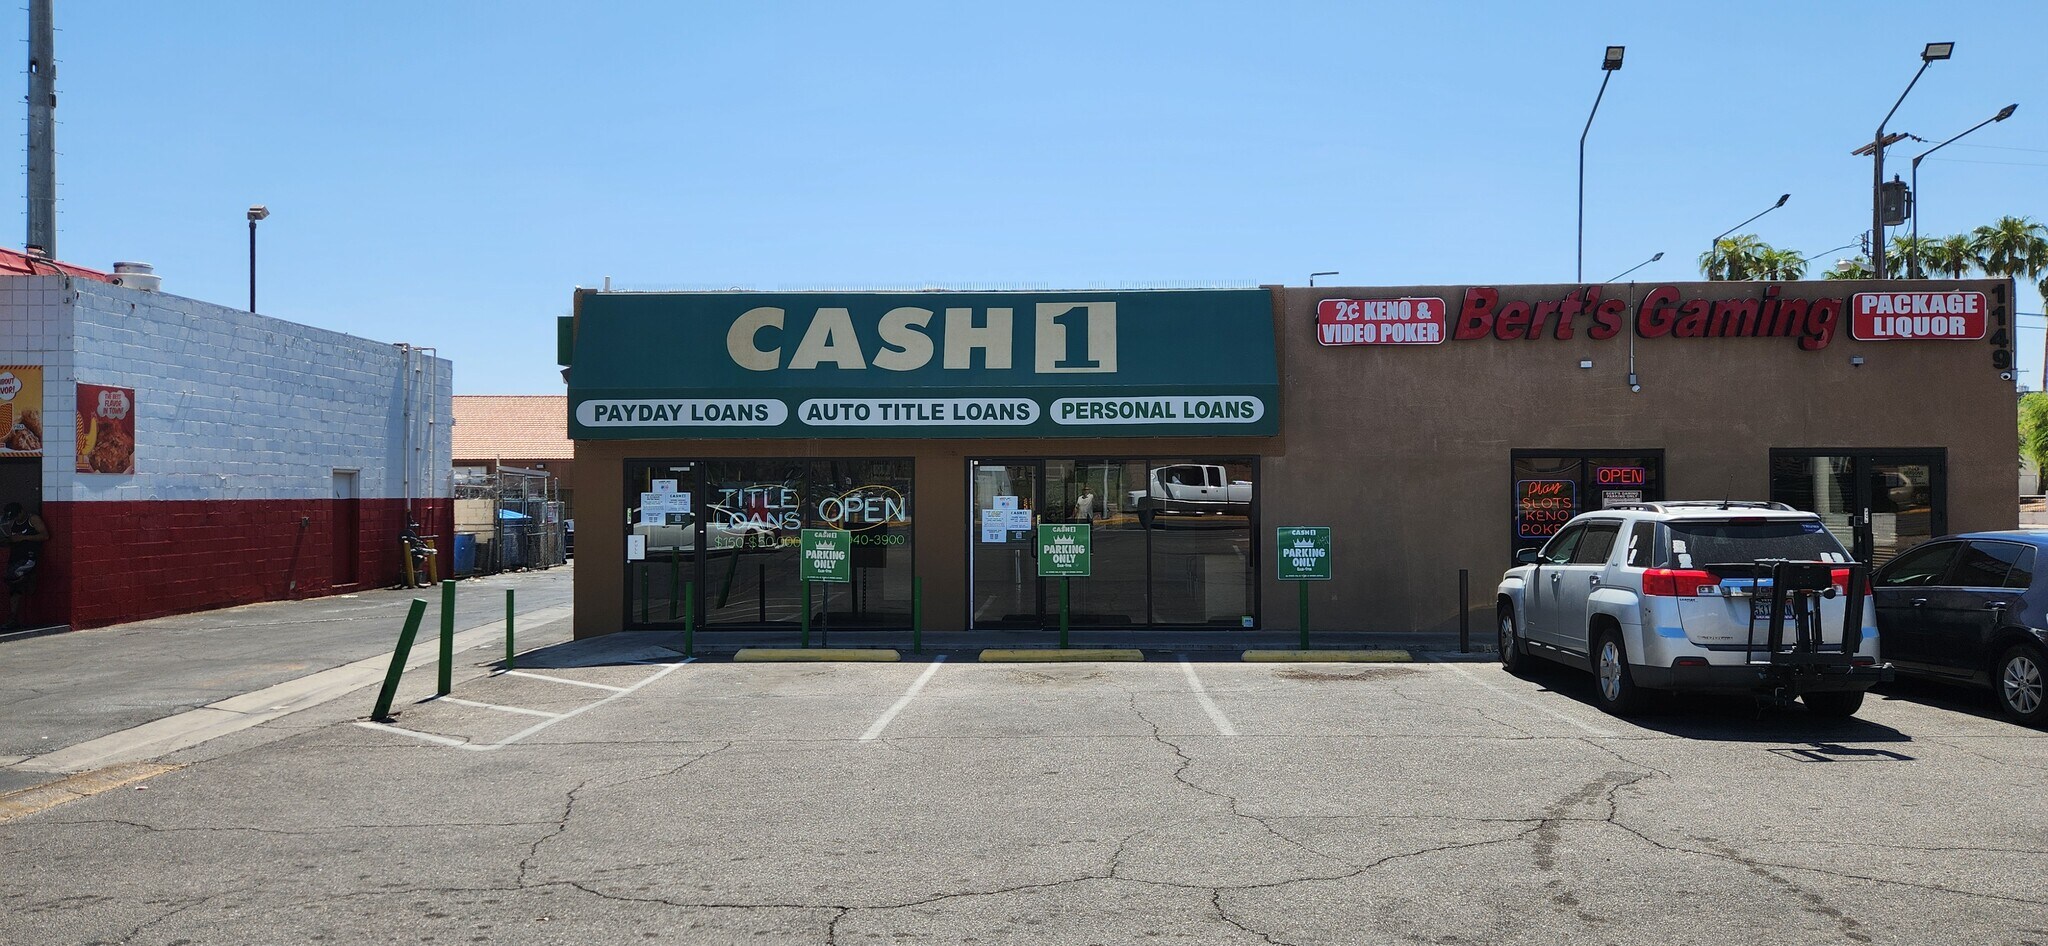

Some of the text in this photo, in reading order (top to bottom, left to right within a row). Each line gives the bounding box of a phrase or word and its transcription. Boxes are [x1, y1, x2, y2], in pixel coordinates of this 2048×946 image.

[1335, 301, 1432, 321] 2¢ KENO &
[1861, 294, 1979, 315] PACKAGE
[1452, 285, 1842, 350] Bert's Gaming
[1990, 283, 2011, 370] 1149
[1322, 322, 1440, 343] VIDEO POKER
[1873, 316, 1966, 338] LIQUOR
[726, 306, 1013, 371] CASH
[594, 404, 769, 422] PAYDAY LOANS
[806, 402, 1031, 421] AUTO TITLE LOANS
[1061, 401, 1255, 420] PERSONAL LOANS
[1600, 469, 1642, 483] OPEN
[1528, 481, 1563, 497] Play
[718, 488, 798, 509] TITLE
[1522, 497, 1572, 509] SLOTS
[818, 497, 906, 522] OPEN
[1525, 510, 1569, 521] KENO
[716, 511, 801, 530] LOANS
[1521, 523, 1562, 535] POKE
[805, 550, 846, 560] PARKING
[1043, 544, 1086, 554] PARKING
[1283, 548, 1326, 557] PARKING
[813, 560, 837, 569] ONLY
[1052, 554, 1076, 563] ONLY
[1292, 558, 1317, 567] ONLY
